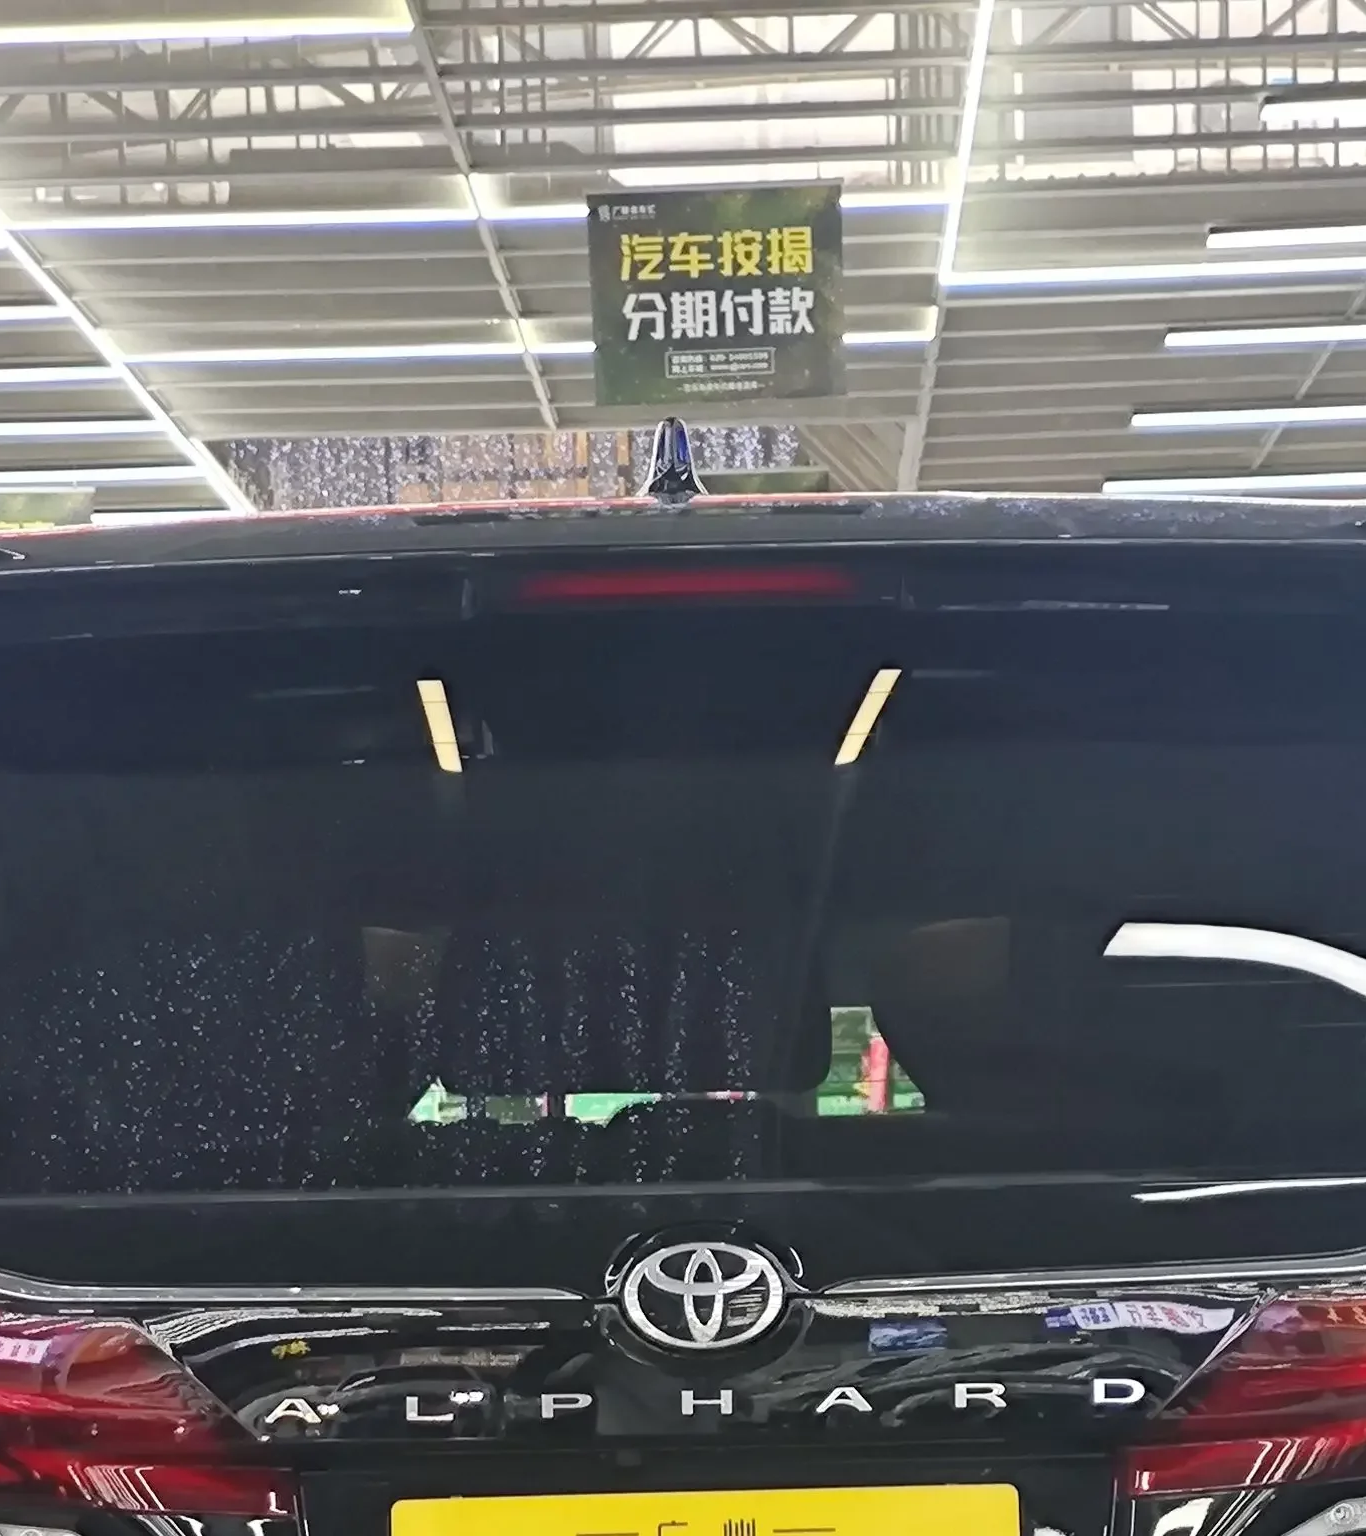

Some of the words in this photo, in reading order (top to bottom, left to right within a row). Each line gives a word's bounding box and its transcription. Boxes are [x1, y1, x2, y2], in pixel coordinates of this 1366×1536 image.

[620, 226, 814, 281] 汽车按揭
[622, 286, 815, 341] 分期付款
[263, 1376, 1148, 1425] ALPHARD
